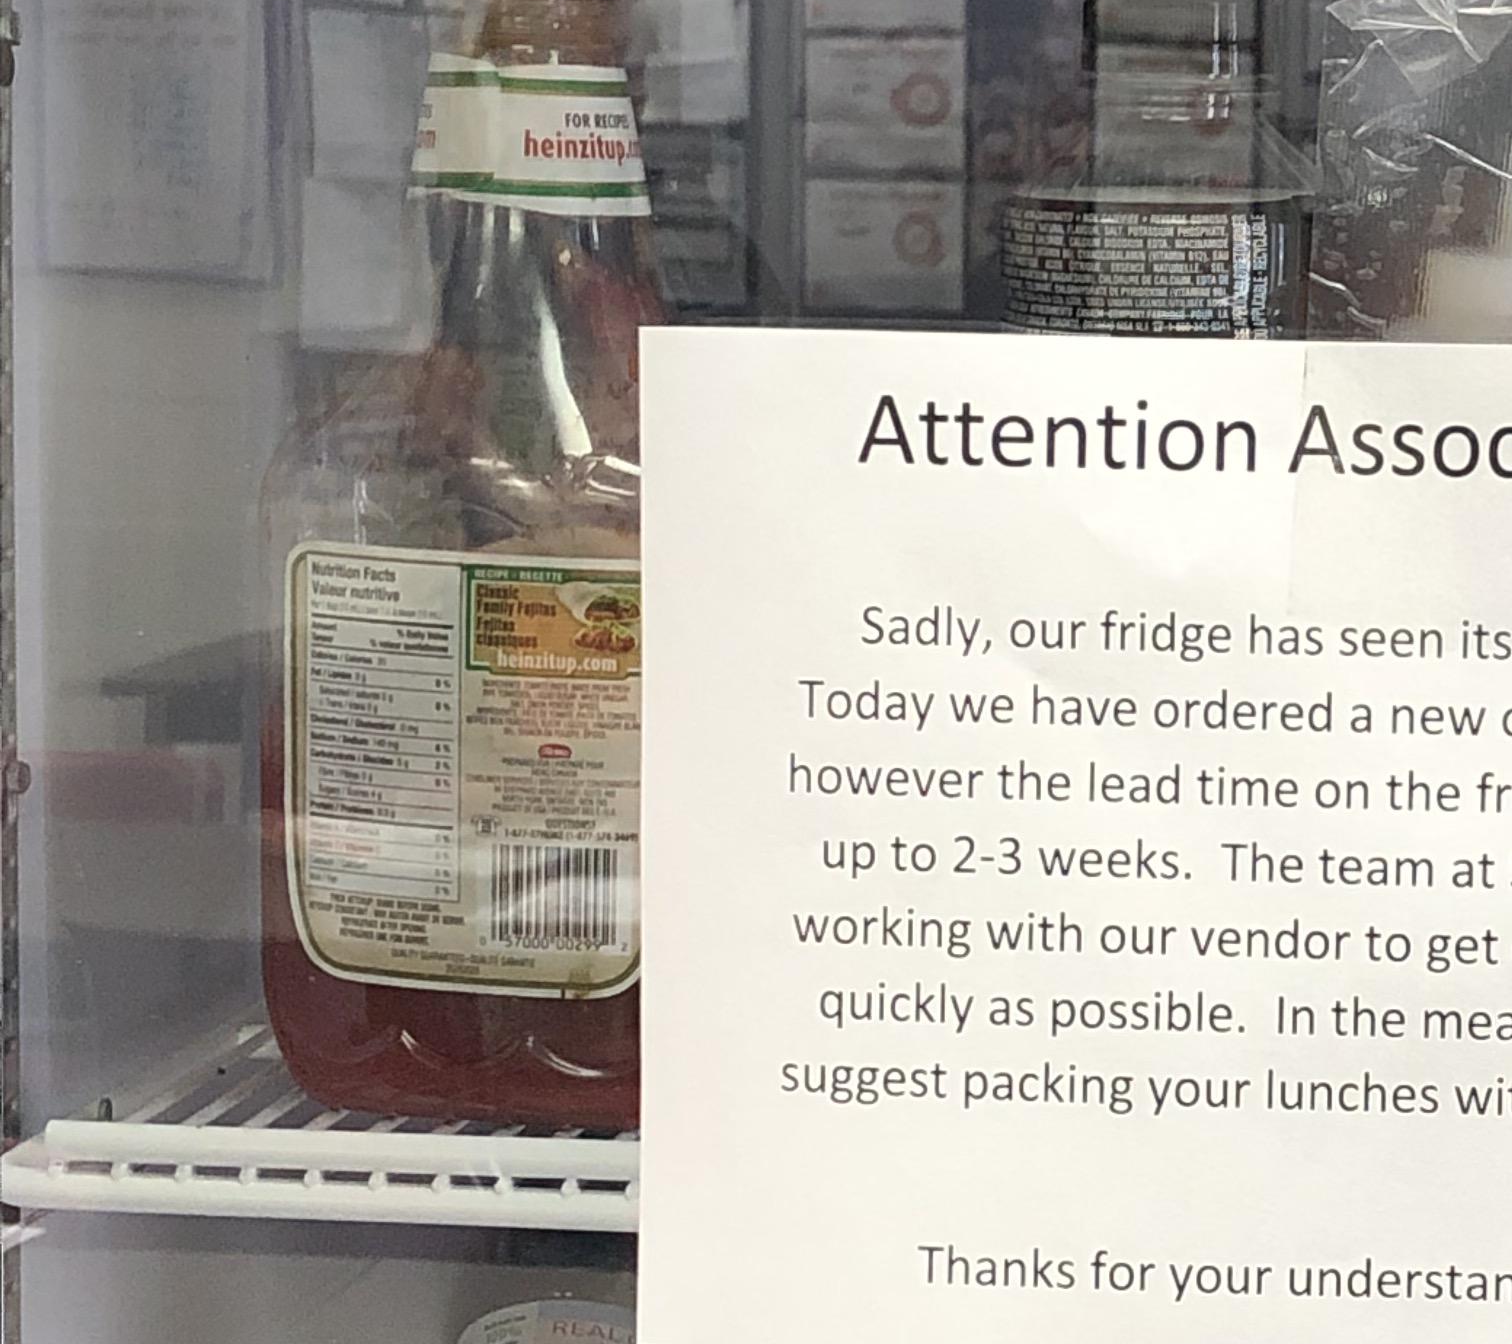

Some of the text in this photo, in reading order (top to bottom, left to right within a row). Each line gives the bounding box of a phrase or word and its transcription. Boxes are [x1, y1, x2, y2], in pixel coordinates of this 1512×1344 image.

[565, 113, 591, 128] FOR
[857, 394, 1257, 473] Attention
[311, 561, 396, 584] Nutrition Facts
[312, 580, 400, 603] Valeur nutritive
[497, 649, 618, 675] heinzitup.com
[861, 605, 992, 657] Sadly,
[1009, 619, 1087, 650] our
[1100, 609, 1232, 663] fridge
[1249, 613, 1324, 657] has
[1339, 627, 1443, 659] seen
[1462, 619, 1512, 661] its
[798, 679, 935, 732] Today
[949, 693, 1014, 724] we
[1032, 684, 1137, 727] have
[1153, 688, 1333, 733] ordered
[1350, 703, 1372, 734] a
[1391, 704, 1487, 736] new
[789, 752, 984, 799] however
[997, 759, 1071, 802] the
[1089, 761, 1180, 805] lead
[1196, 766, 1299, 808] time
[1315, 779, 1369, 810] on
[1385, 769, 1461, 812] the
[823, 840, 876, 880] up
[890, 836, 937, 872] to
[953, 835, 1022, 875] 2-3
[1038, 838, 1192, 880] weeks.
[1220, 841, 1304, 884] The
[1318, 848, 1434, 888] team
[1451, 853, 1496, 890] at
[792, 905, 972, 959] working
[986, 911, 1082, 953] with
[1099, 924, 1177, 955] our
[1190, 918, 1352, 961] vendor
[1364, 925, 1412, 963] to
[1426, 929, 1499, 974] get
[819, 981, 974, 1034] quickly
[989, 996, 1034, 1027] as
[1051, 990, 1245, 1038] possible.
[1277, 995, 1315, 1036] In
[1331, 995, 1406, 1038] the
[781, 1063, 947, 1105] suggest
[964, 1061, 1134, 1115] packing
[1148, 1076, 1251, 1116] your
[1267, 1068, 1439, 1114] lunches
[917, 1244, 1076, 1290] Thanks
[1090, 1249, 1156, 1291] for
[1169, 1263, 1273, 1303] your
